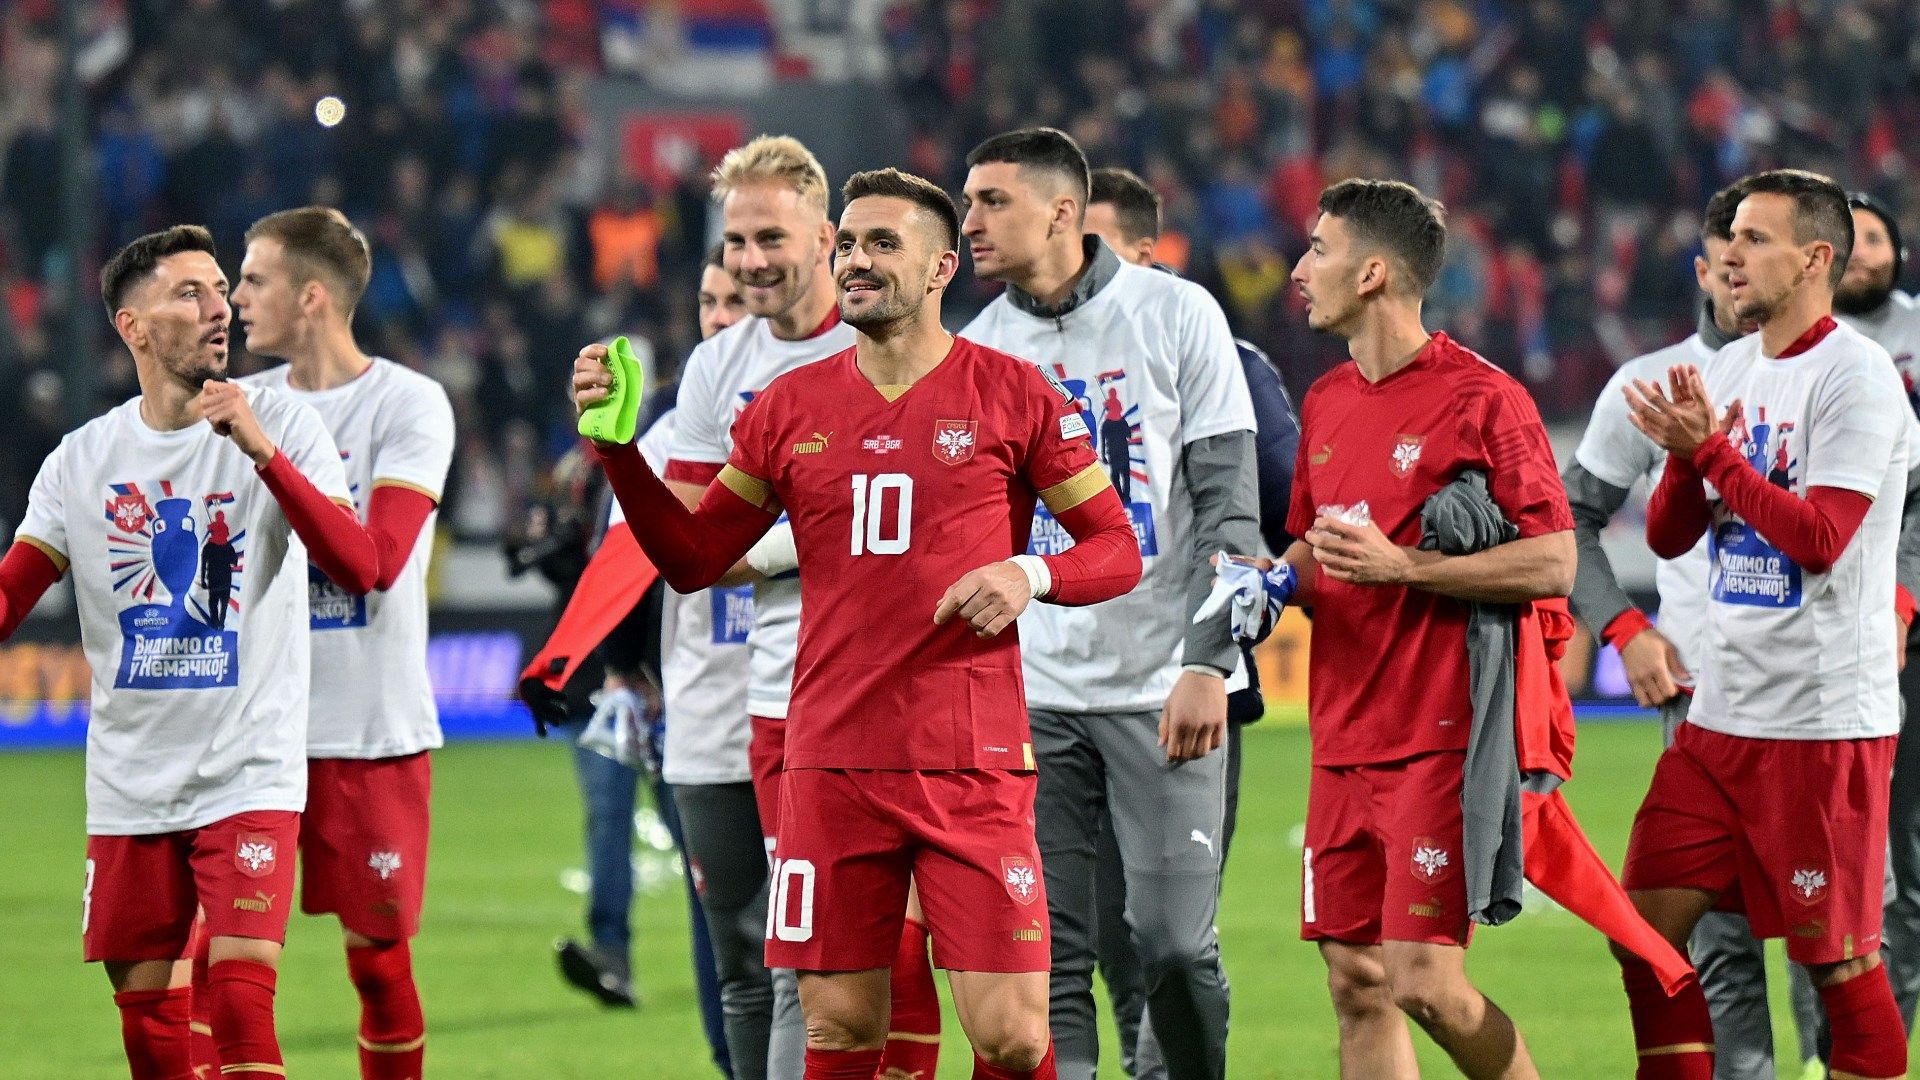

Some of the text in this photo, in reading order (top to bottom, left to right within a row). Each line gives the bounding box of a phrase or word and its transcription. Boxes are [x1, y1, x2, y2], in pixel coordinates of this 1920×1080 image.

[792, 442, 823, 454] PUMA
[851, 473, 914, 555] 10
[134, 634, 223, 655] Видимо се
[233, 898, 267, 913] PUMA
